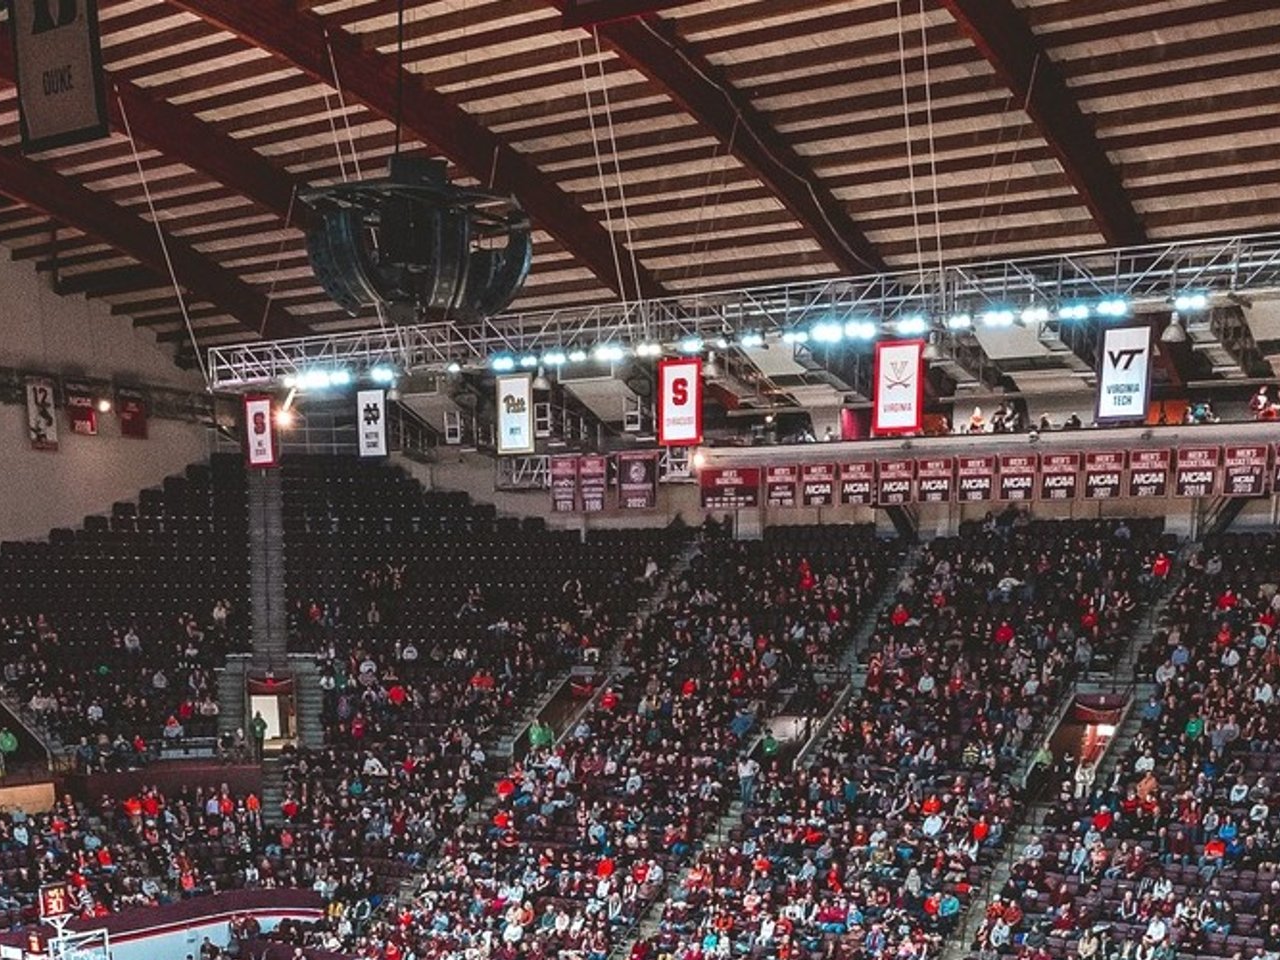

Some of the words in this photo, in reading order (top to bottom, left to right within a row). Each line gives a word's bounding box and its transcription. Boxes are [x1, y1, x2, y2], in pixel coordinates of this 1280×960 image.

[42, 65, 74, 96] DUKE
[1108, 350, 1145, 370] VT
[672, 378, 688, 406] S
[1106, 383, 1140, 395] VIRGINIA
[1113, 395, 1132, 406] TECH
[883, 403, 912, 413] VIRGINIA
[1045, 476, 1074, 487] NCAA
[1088, 474, 1118, 485] NCAA
[1133, 473, 1164, 484] NCAA
[1180, 471, 1212, 483] NCAA
[844, 482, 869, 493] NCAA
[882, 481, 909, 492] NCAA
[921, 479, 948, 490] NCAA
[961, 478, 990, 489] NCAA
[1003, 478, 1031, 488] NCAA
[805, 484, 830, 495] NCAA
[46, 898, 64, 915] 30
